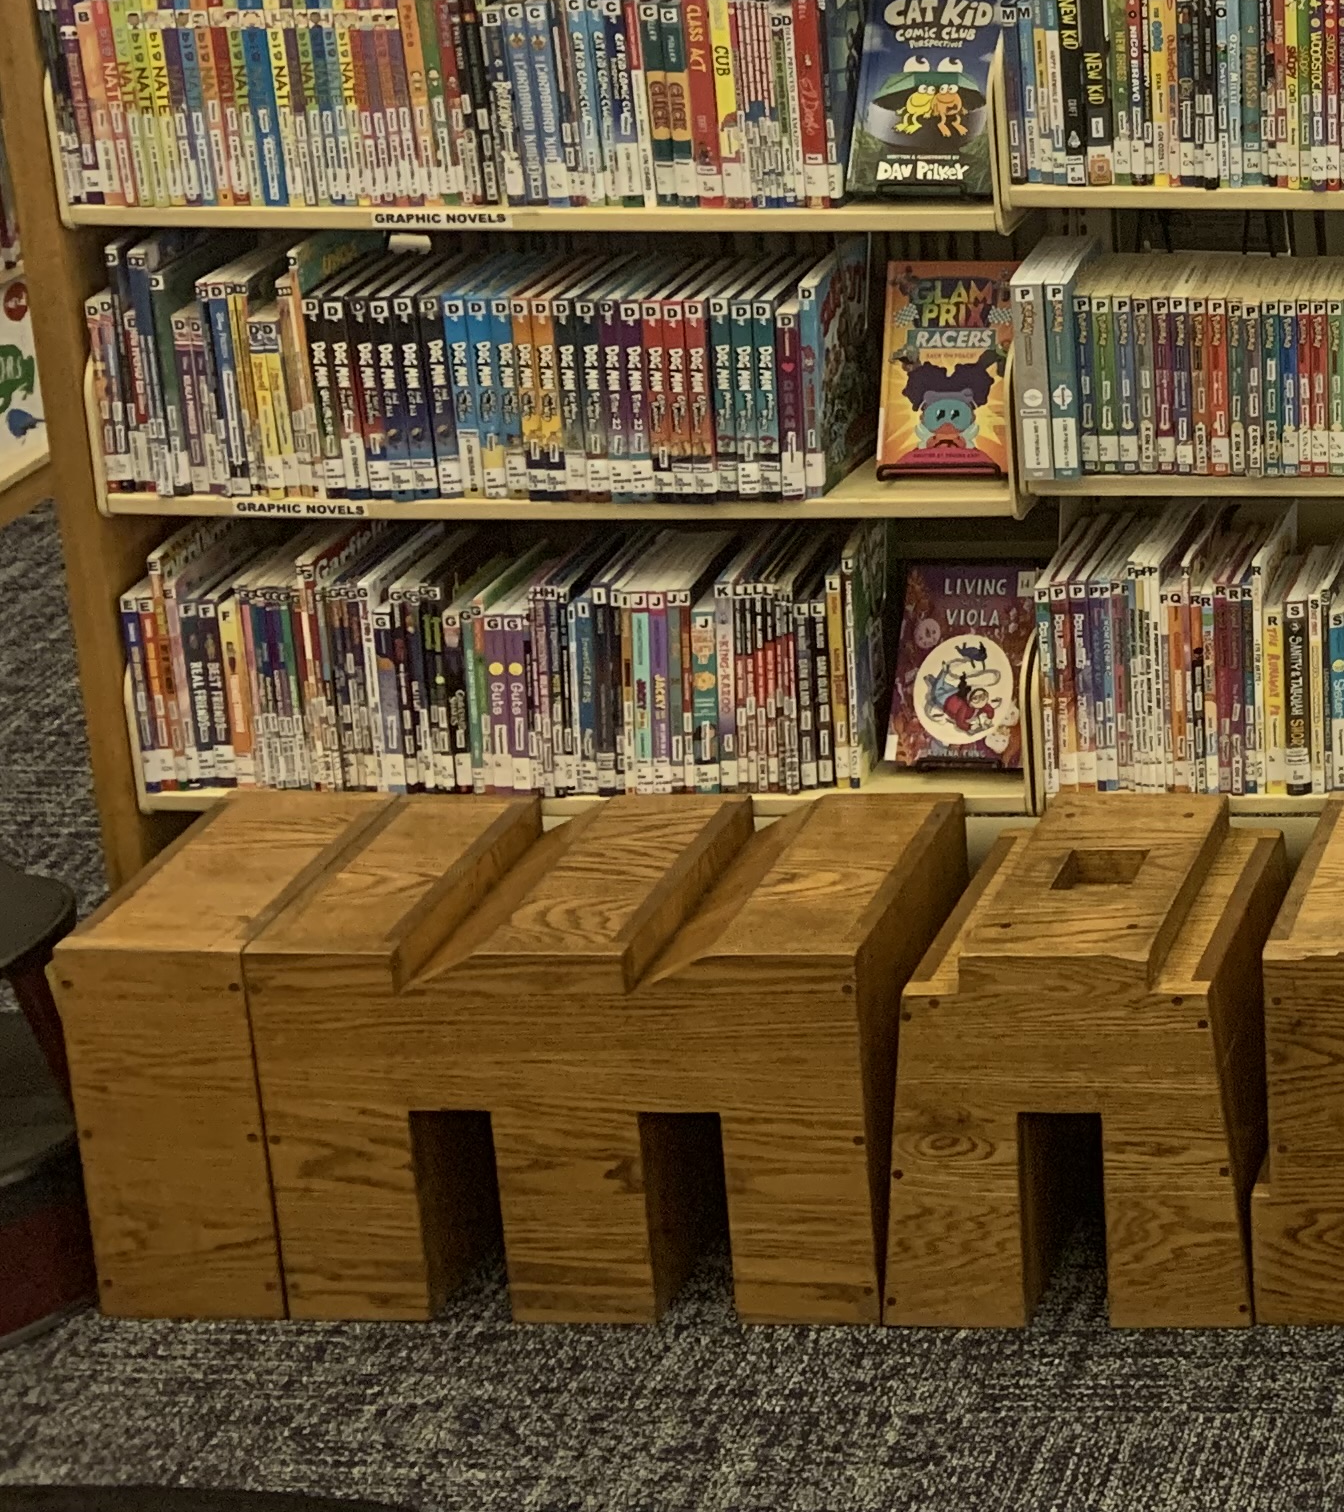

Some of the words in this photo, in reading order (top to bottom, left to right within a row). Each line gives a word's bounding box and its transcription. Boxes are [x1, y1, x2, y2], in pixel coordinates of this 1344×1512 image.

[685, 5, 702, 42] CLASS
[941, 25, 977, 42] CLUB
[689, 47, 706, 72] ACT
[715, 45, 730, 77] CUB
[154, 65, 171, 117] NATE
[668, 82, 687, 131] CLICK
[876, 161, 913, 181] DAV
[375, 213, 442, 224] GRAPHIC
[446, 213, 506, 224] NOVELS
[913, 279, 995, 305] GLAM
[921, 302, 985, 328] PRIX
[915, 329, 994, 349] RACERS
[475, 342, 492, 365] DOG
[477, 366, 493, 387] MAN
[236, 502, 301, 515] GRAPHIC
[307, 503, 365, 516] NOVELS
[944, 577, 1008, 596] LIVING
[945, 608, 1001, 626] VIOLA
[491, 682, 505, 715] Guts
